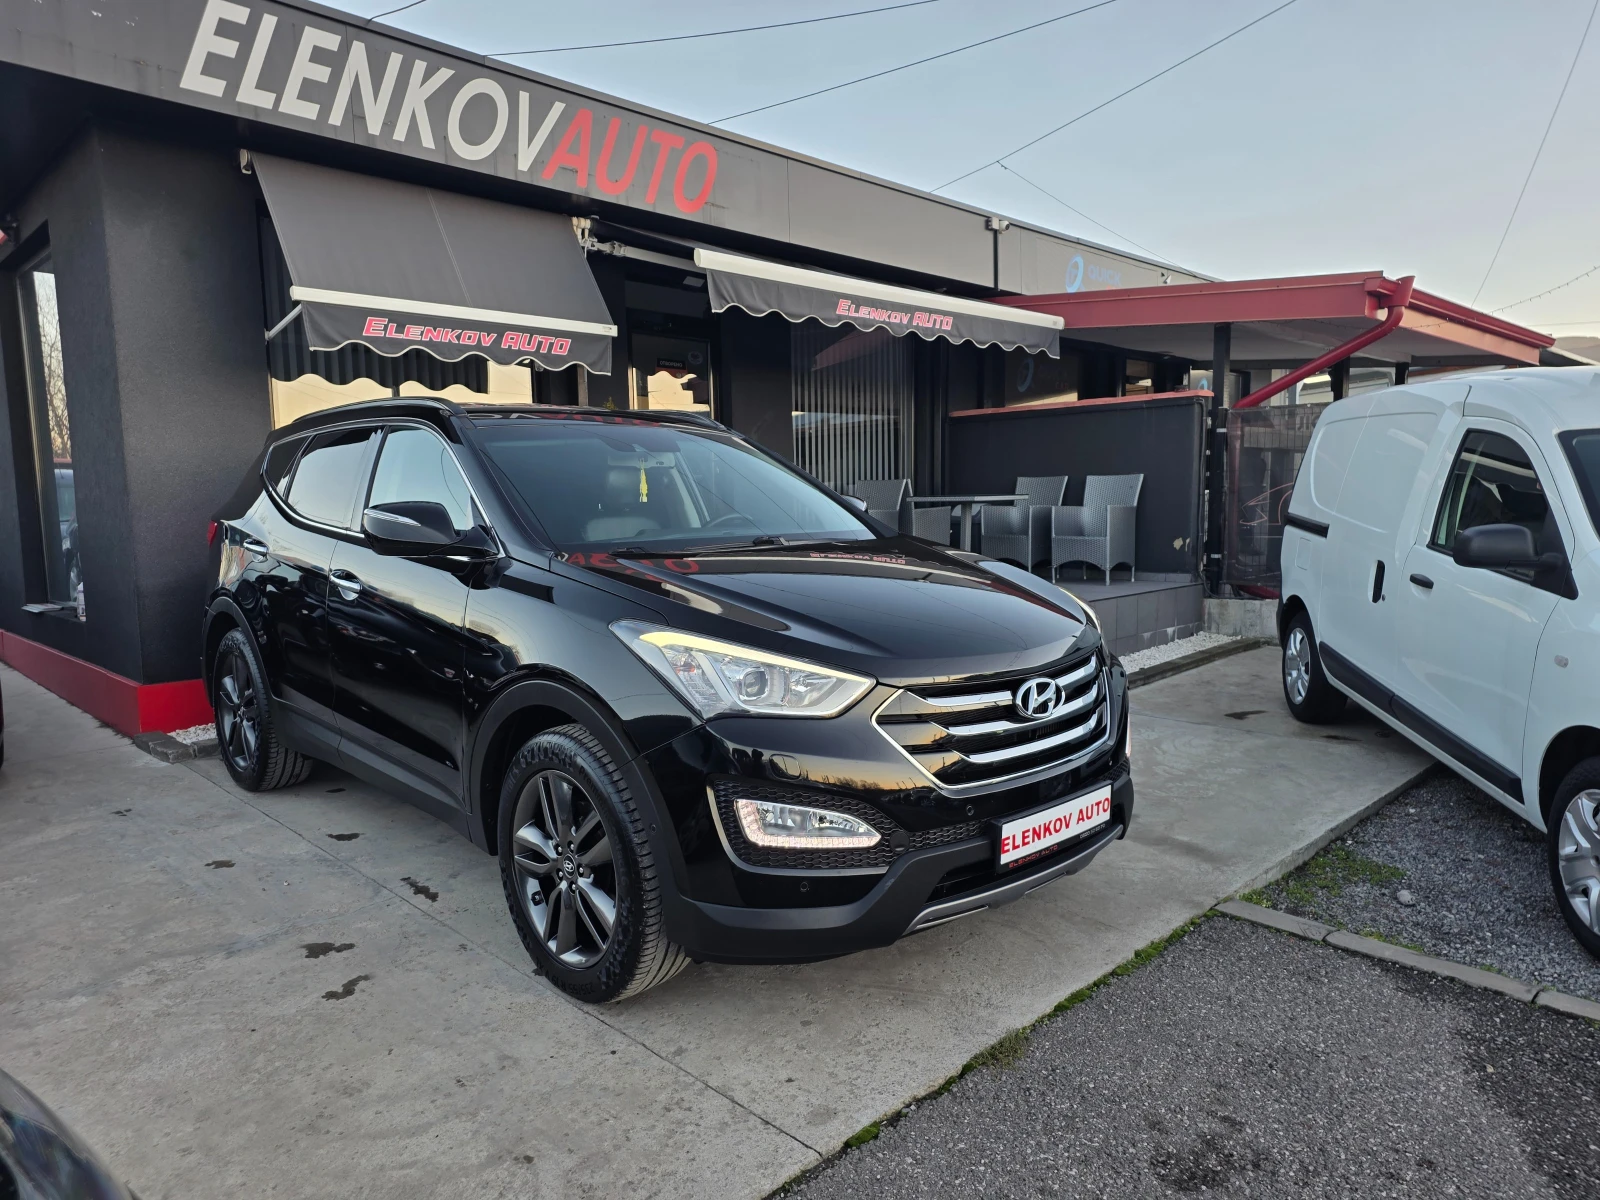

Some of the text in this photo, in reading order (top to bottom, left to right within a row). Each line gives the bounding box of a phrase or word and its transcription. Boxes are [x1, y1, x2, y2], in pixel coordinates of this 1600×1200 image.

[1088, 264, 1123, 287] QUICK
[836, 299, 954, 330] ELENKOV AUTO
[362, 316, 572, 355] ELENKOV AUTO
[1001, 797, 1111, 855] ELENKOV AUTO
